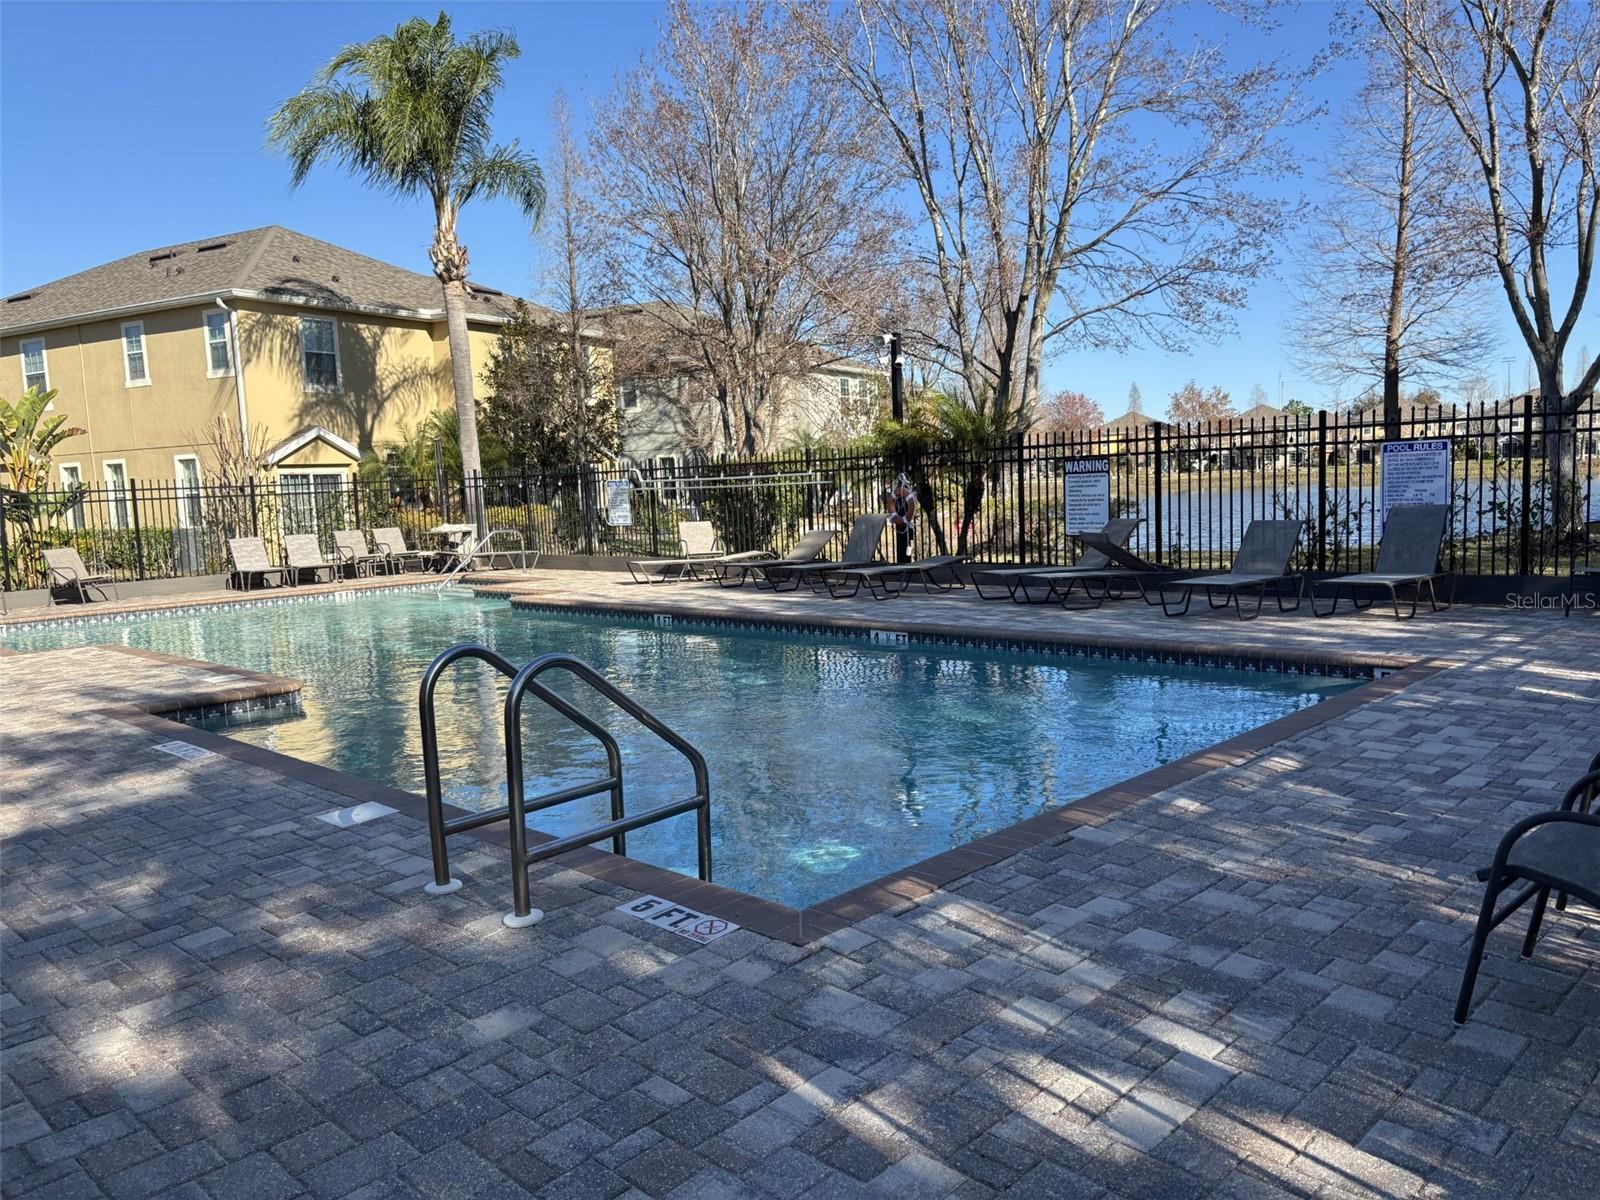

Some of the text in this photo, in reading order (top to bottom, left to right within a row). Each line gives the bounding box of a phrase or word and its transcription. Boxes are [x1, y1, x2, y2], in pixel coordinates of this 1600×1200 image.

[1387, 442, 1443, 452] POOL RULES
[1065, 460, 1109, 473] WARNING
[630, 899, 662, 912] 5
